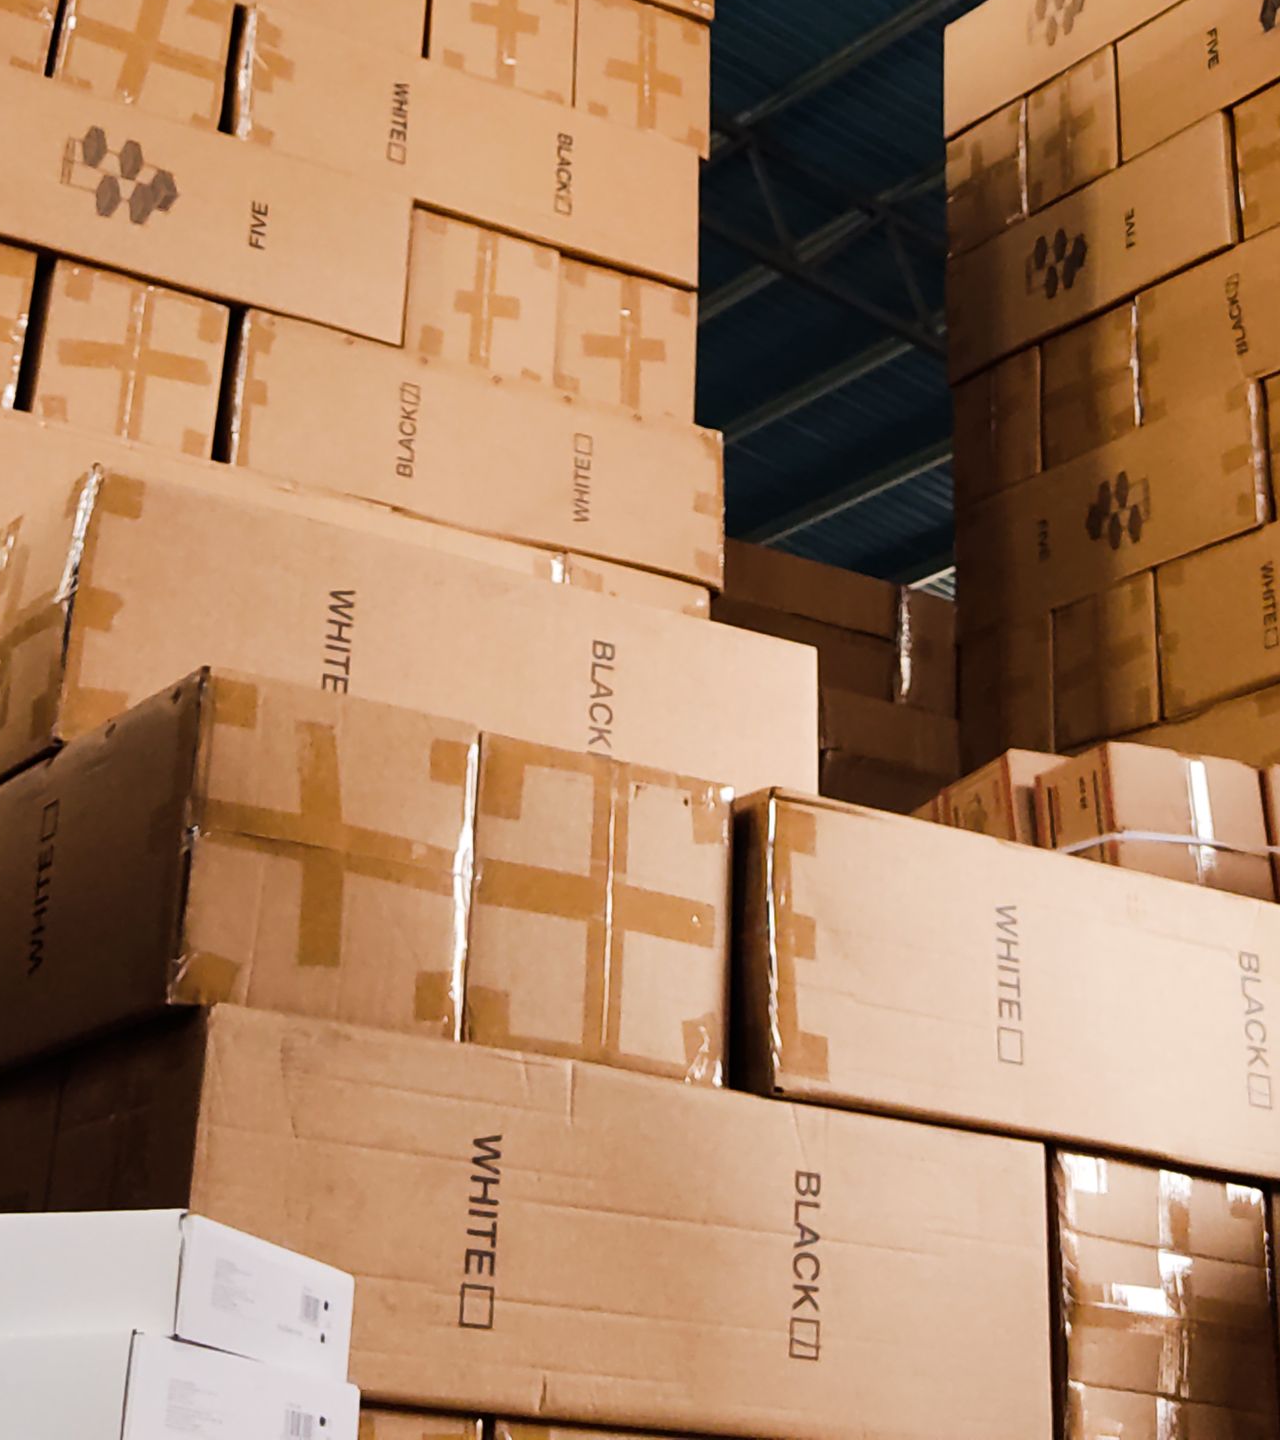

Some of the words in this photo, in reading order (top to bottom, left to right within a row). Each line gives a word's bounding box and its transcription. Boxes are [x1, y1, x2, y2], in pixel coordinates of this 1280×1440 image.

[1206, 27, 1220, 70] FIVE
[389, 82, 409, 142] WHITE
[556, 132, 573, 193] BLACK
[248, 200, 268, 250] FIVE
[1226, 295, 1248, 356] BLACK
[396, 408, 418, 478] BLACK
[573, 456, 591, 523] WHITE
[1261, 560, 1278, 626] WHITE
[321, 589, 356, 694] WHITE
[588, 639, 616, 749] BLACK
[27, 845, 54, 977] WHITE
[995, 905, 1022, 1022] WHITE
[1239, 950, 1268, 1068] BLACK
[464, 1134, 502, 1277] WHITE
[792, 1170, 822, 1312] BLACK
